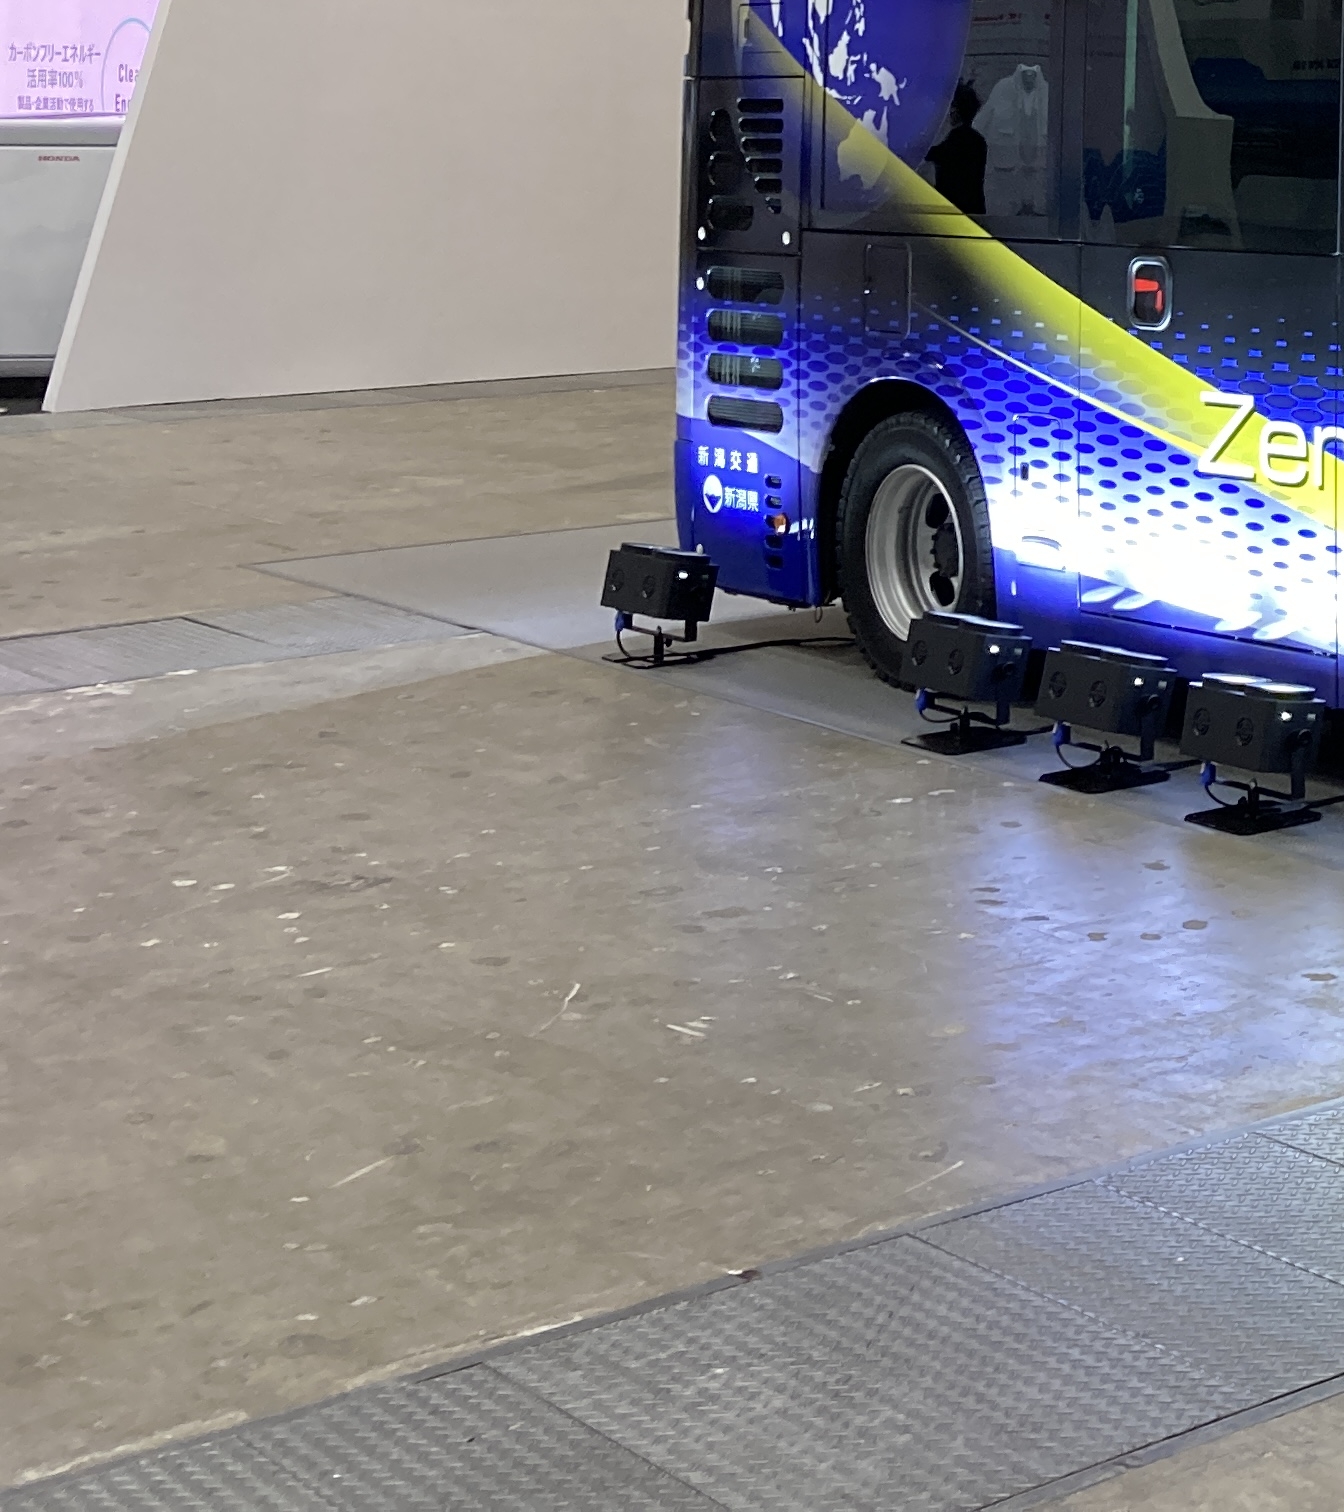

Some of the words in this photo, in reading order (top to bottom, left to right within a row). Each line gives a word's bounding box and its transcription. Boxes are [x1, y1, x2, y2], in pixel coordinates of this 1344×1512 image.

[8, 42, 101, 64] カーボンフリーエネルギー
